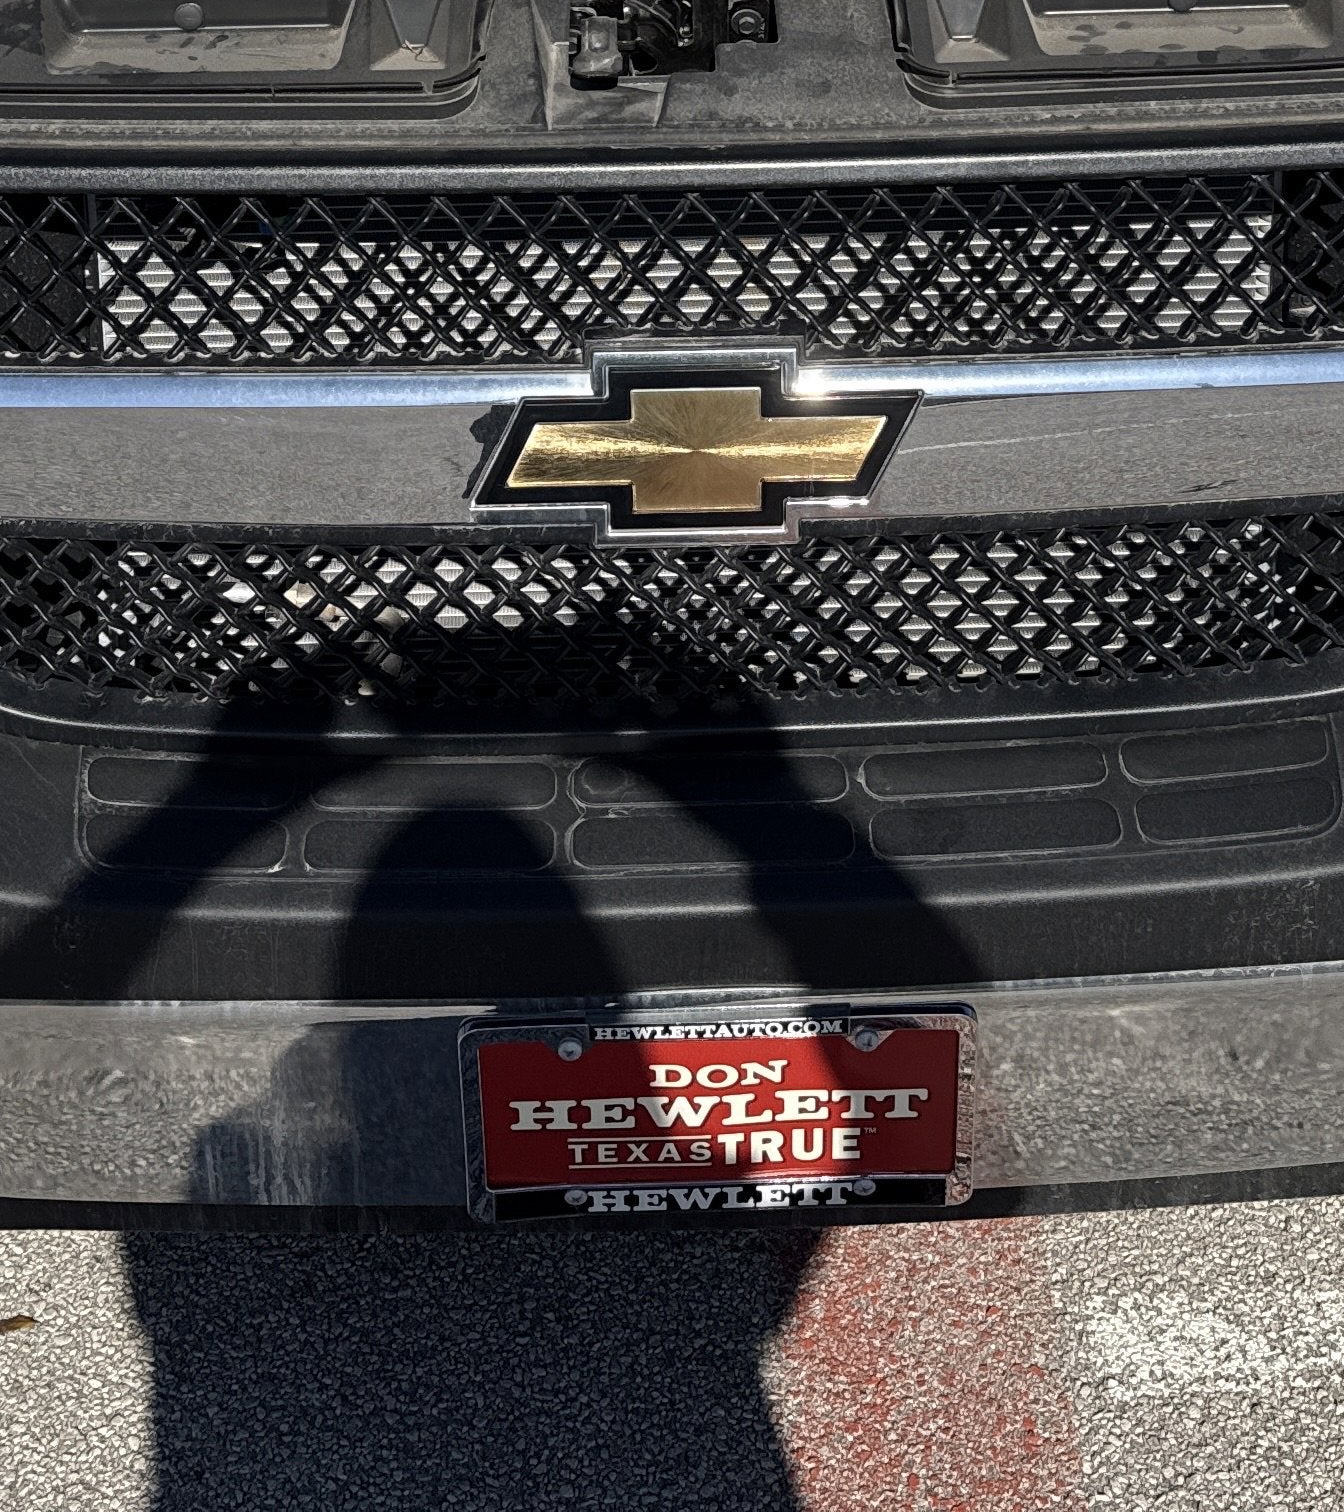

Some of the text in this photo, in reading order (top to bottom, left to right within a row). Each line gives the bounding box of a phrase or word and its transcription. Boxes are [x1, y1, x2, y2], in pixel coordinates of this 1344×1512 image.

[594, 1019, 843, 1040] HEWLETTAUTO.COM
[648, 1059, 788, 1089] DON
[509, 1088, 929, 1131] HEWLETT
[587, 1182, 853, 1213] HEWLETT
